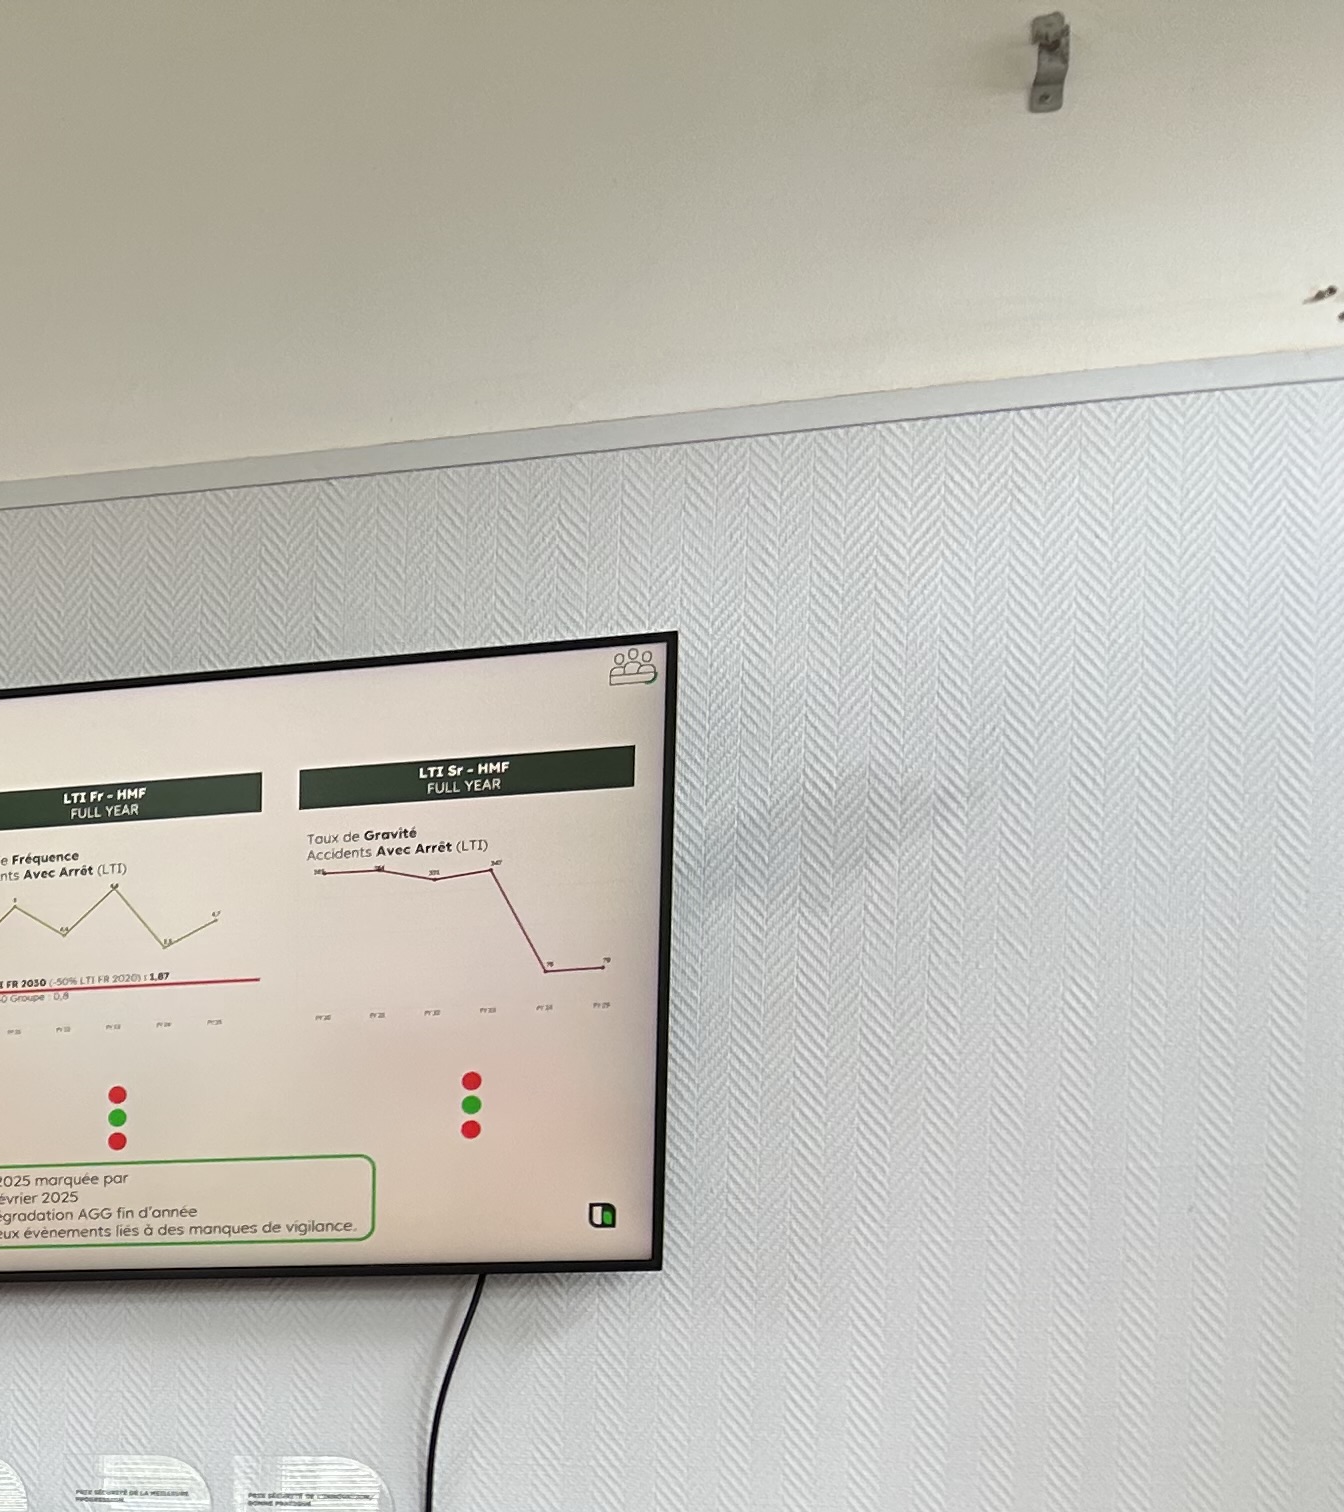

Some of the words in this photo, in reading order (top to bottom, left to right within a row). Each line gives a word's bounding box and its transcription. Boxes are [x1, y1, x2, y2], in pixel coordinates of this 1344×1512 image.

[418, 766, 444, 779] LTI
[448, 765, 464, 778] Sr
[478, 761, 510, 775] HMF
[427, 781, 460, 795] FULL
[464, 778, 501, 792] YEAR
[63, 792, 87, 805] LTI
[90, 791, 104, 803] Fr
[116, 787, 147, 801] HMF
[70, 806, 102, 820] FULL
[105, 804, 139, 817] YEAR
[307, 832, 339, 845] Taux
[342, 831, 360, 843] de
[364, 826, 417, 842] Gravité
[307, 847, 372, 862] Accidents
[376, 845, 411, 858] Avec
[414, 841, 453, 854] Arrêt
[456, 839, 488, 854] (LTI)
[12, 852, 80, 867] Fréquence
[23, 870, 56, 880] Avec
[59, 865, 94, 878] Arrêt
[96, 862, 128, 877] (LTI)
[6, 980, 19, 989] FR
[21, 978, 47, 988] 2030
[80, 976, 96, 985] LTI
[98, 974, 110, 984] FR
[10, 992, 45, 1004] Groupe
[34, 1172, 100, 1190] marquée
[103, 1173, 129, 1188] par
[42, 1191, 79, 1204] 2025
[78, 1207, 112, 1221] AGG
[116, 1206, 134, 1220] fin
[138, 1205, 198, 1220] d'année
[116, 1224, 140, 1238] liés
[144, 1224, 154, 1237] à
[158, 1222, 184, 1236] des
[188, 1224, 258, 1238] manques
[262, 1221, 282, 1234] de
